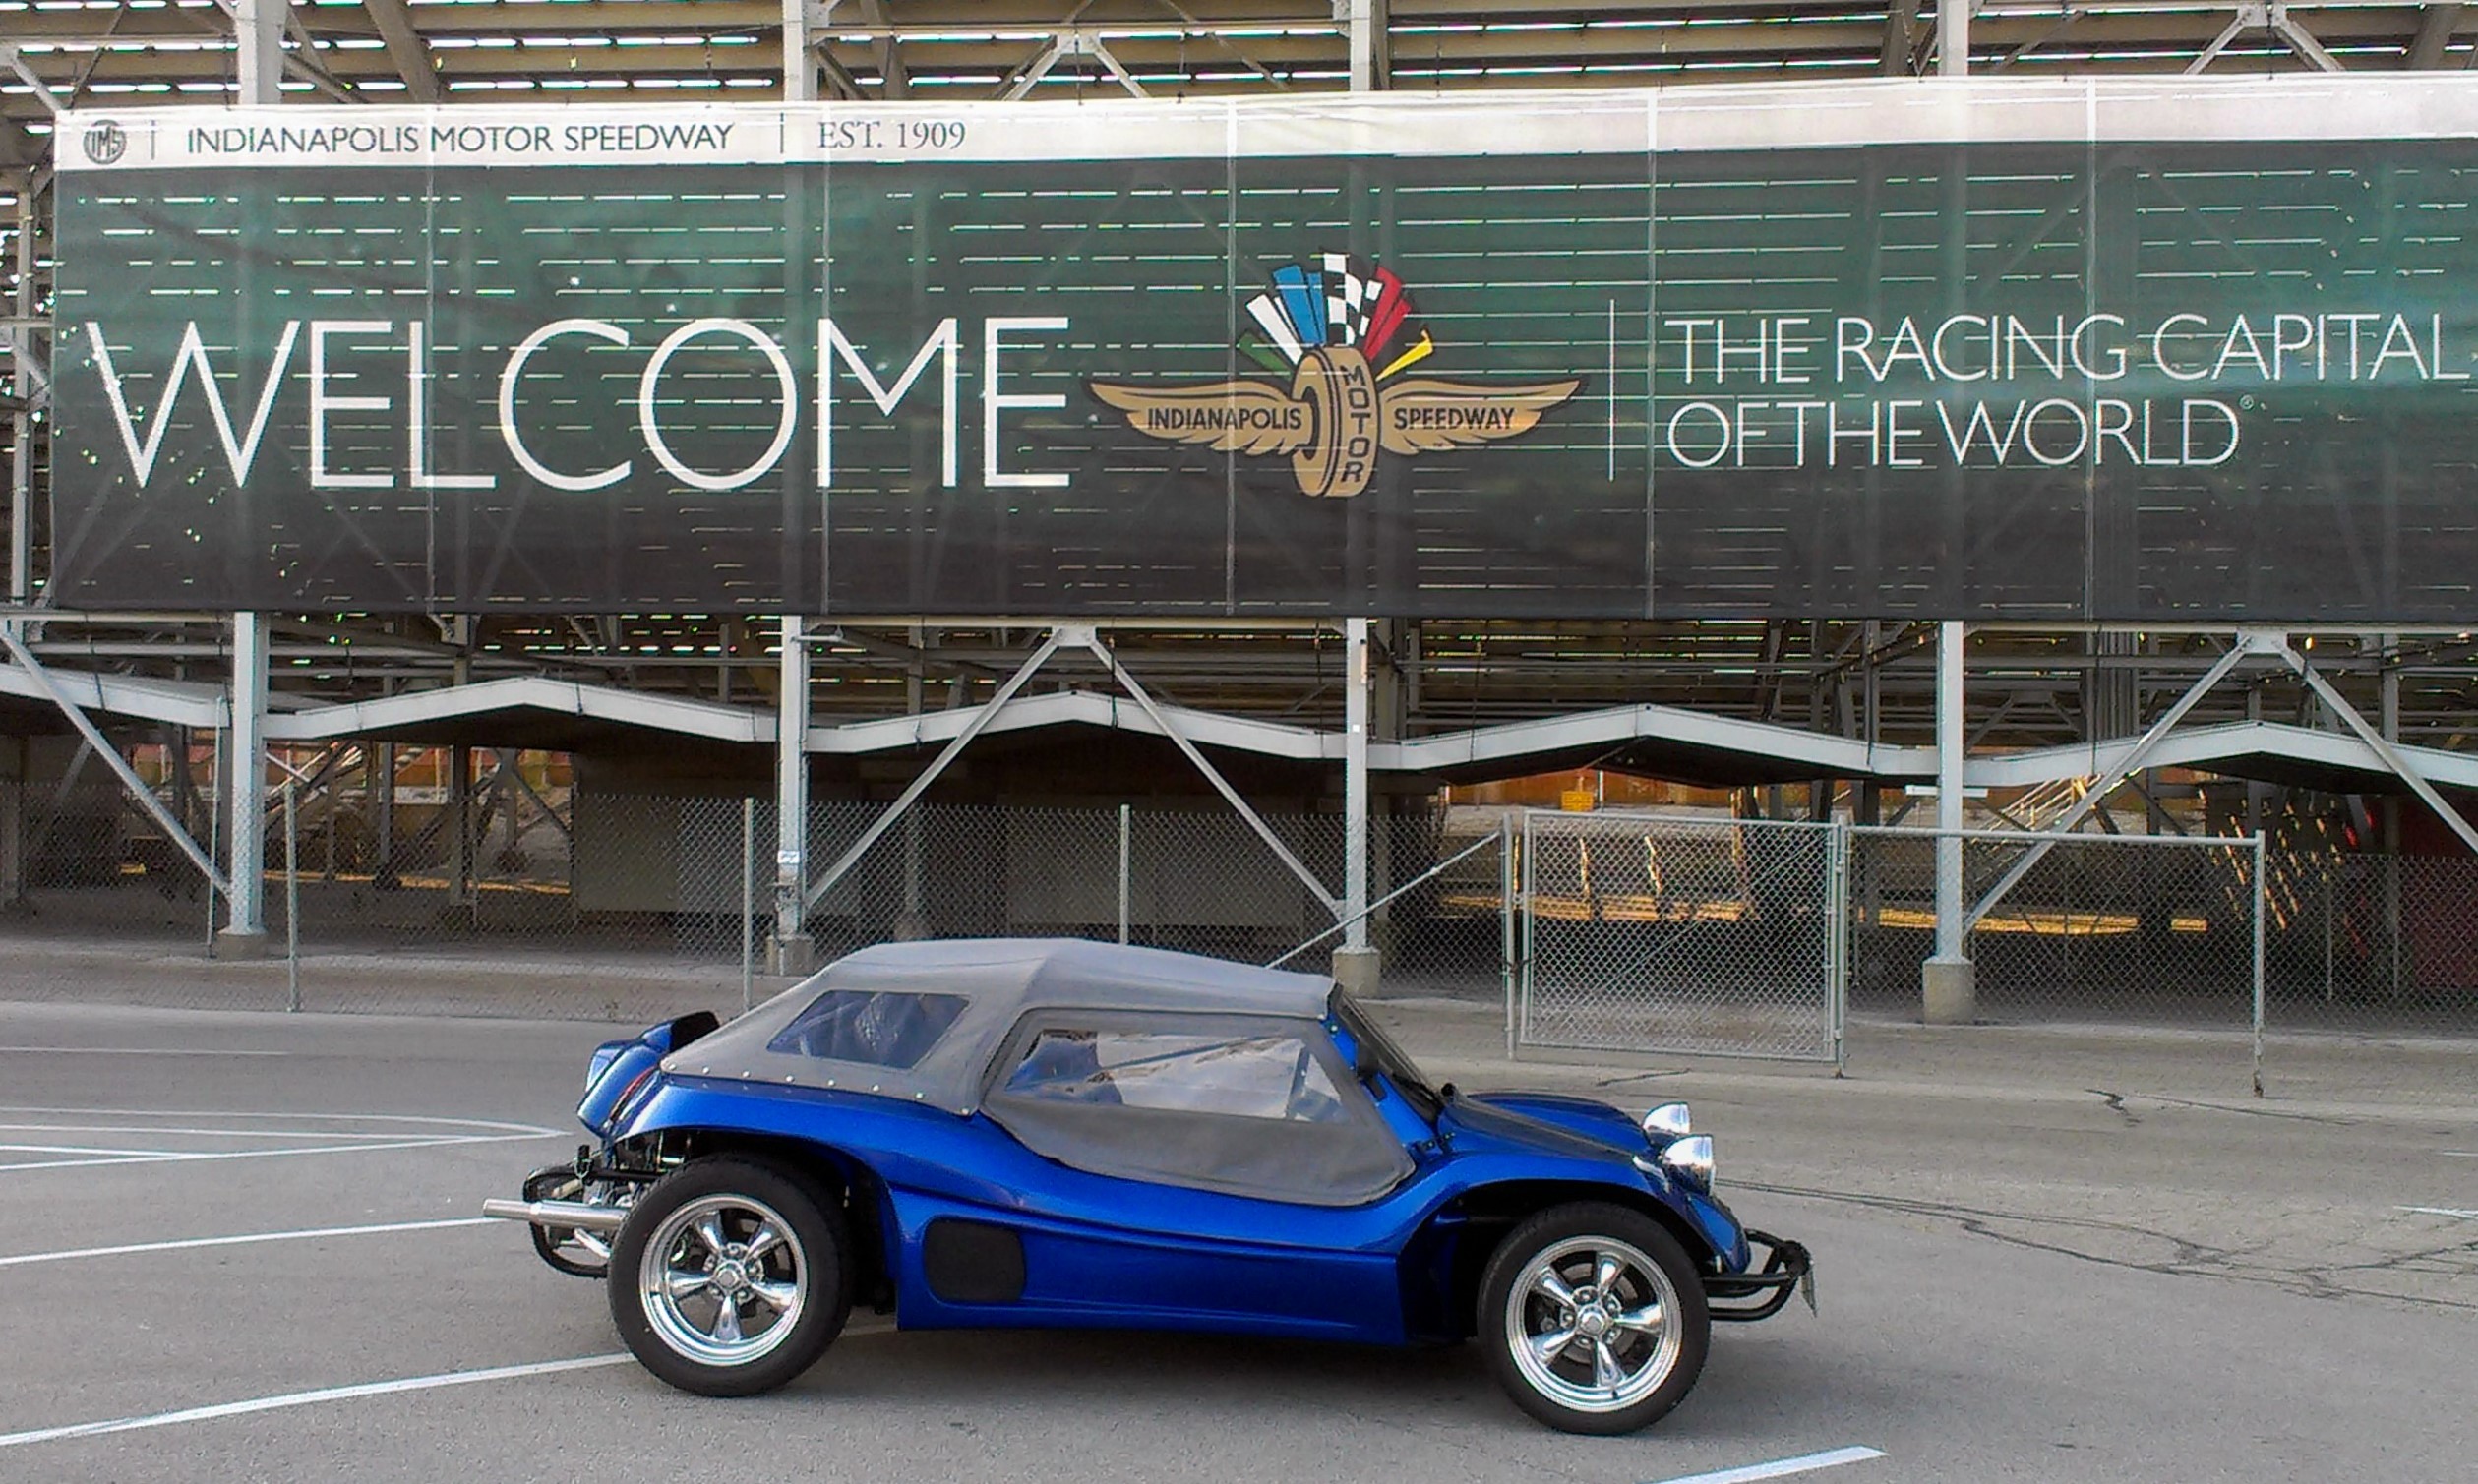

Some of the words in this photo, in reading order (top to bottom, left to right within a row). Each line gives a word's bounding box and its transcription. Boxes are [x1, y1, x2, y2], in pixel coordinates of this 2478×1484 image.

[188, 127, 421, 154] INDIANAPOLIS
[430, 125, 554, 152] MOTOR
[564, 123, 735, 150] SPEEDWAY
[816, 122, 883, 148] EST.
[896, 121, 966, 149] 1909
[1663, 317, 1810, 385] THE
[1836, 313, 2128, 383] RACING
[2152, 312, 2471, 382] CAPITAL
[86, 317, 1072, 492] WELCOME
[1147, 406, 1303, 432] INDIANAPOLIS
[1394, 406, 1516, 431] SPEEDWAY
[1341, 364, 1372, 484] MOTOR
